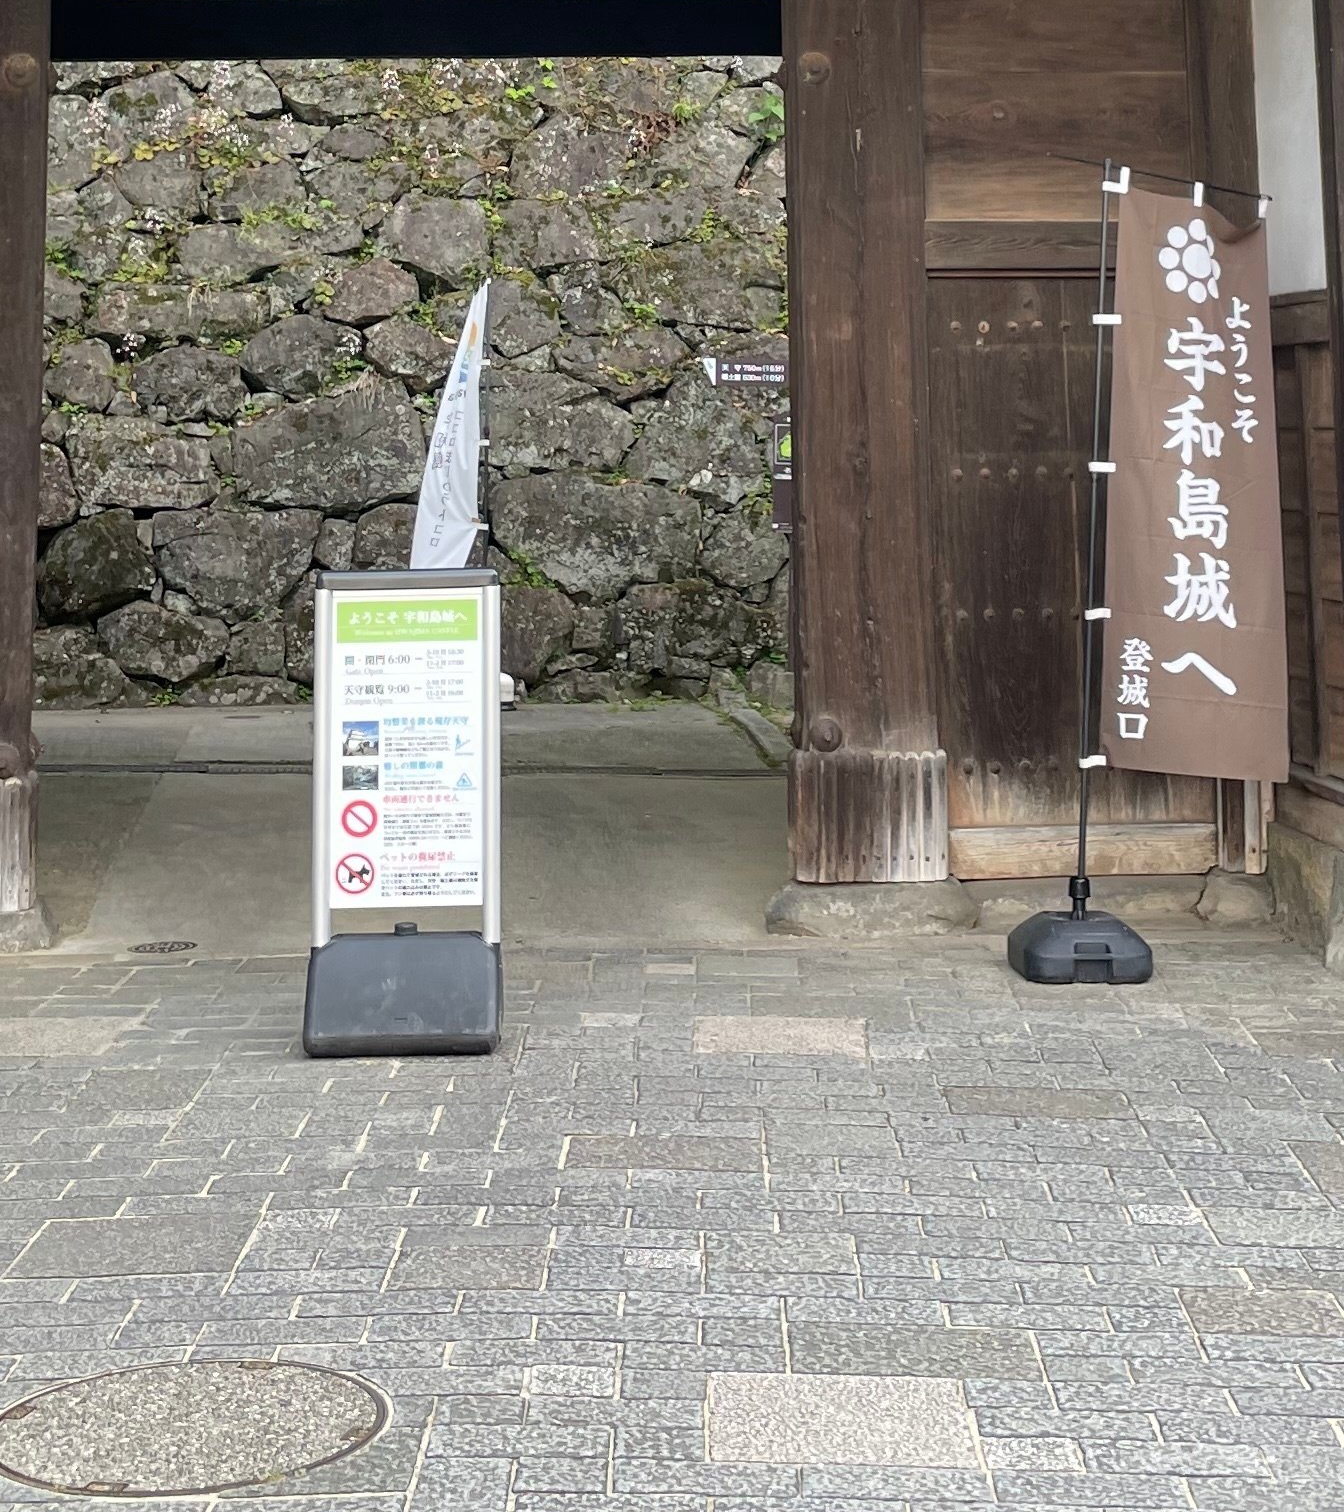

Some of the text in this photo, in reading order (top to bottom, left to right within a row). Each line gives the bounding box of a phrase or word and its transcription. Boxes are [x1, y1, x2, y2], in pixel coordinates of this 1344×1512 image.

[1225, 296, 1257, 445] ようこそ
[1161, 316, 1237, 696] 宇和島城へ
[349, 609, 467, 625] ようこそ 宇和島城へ
[388, 654, 410, 664] 6:00
[1117, 637, 1154, 740] 登城口
[387, 684, 410, 694] 9:00
